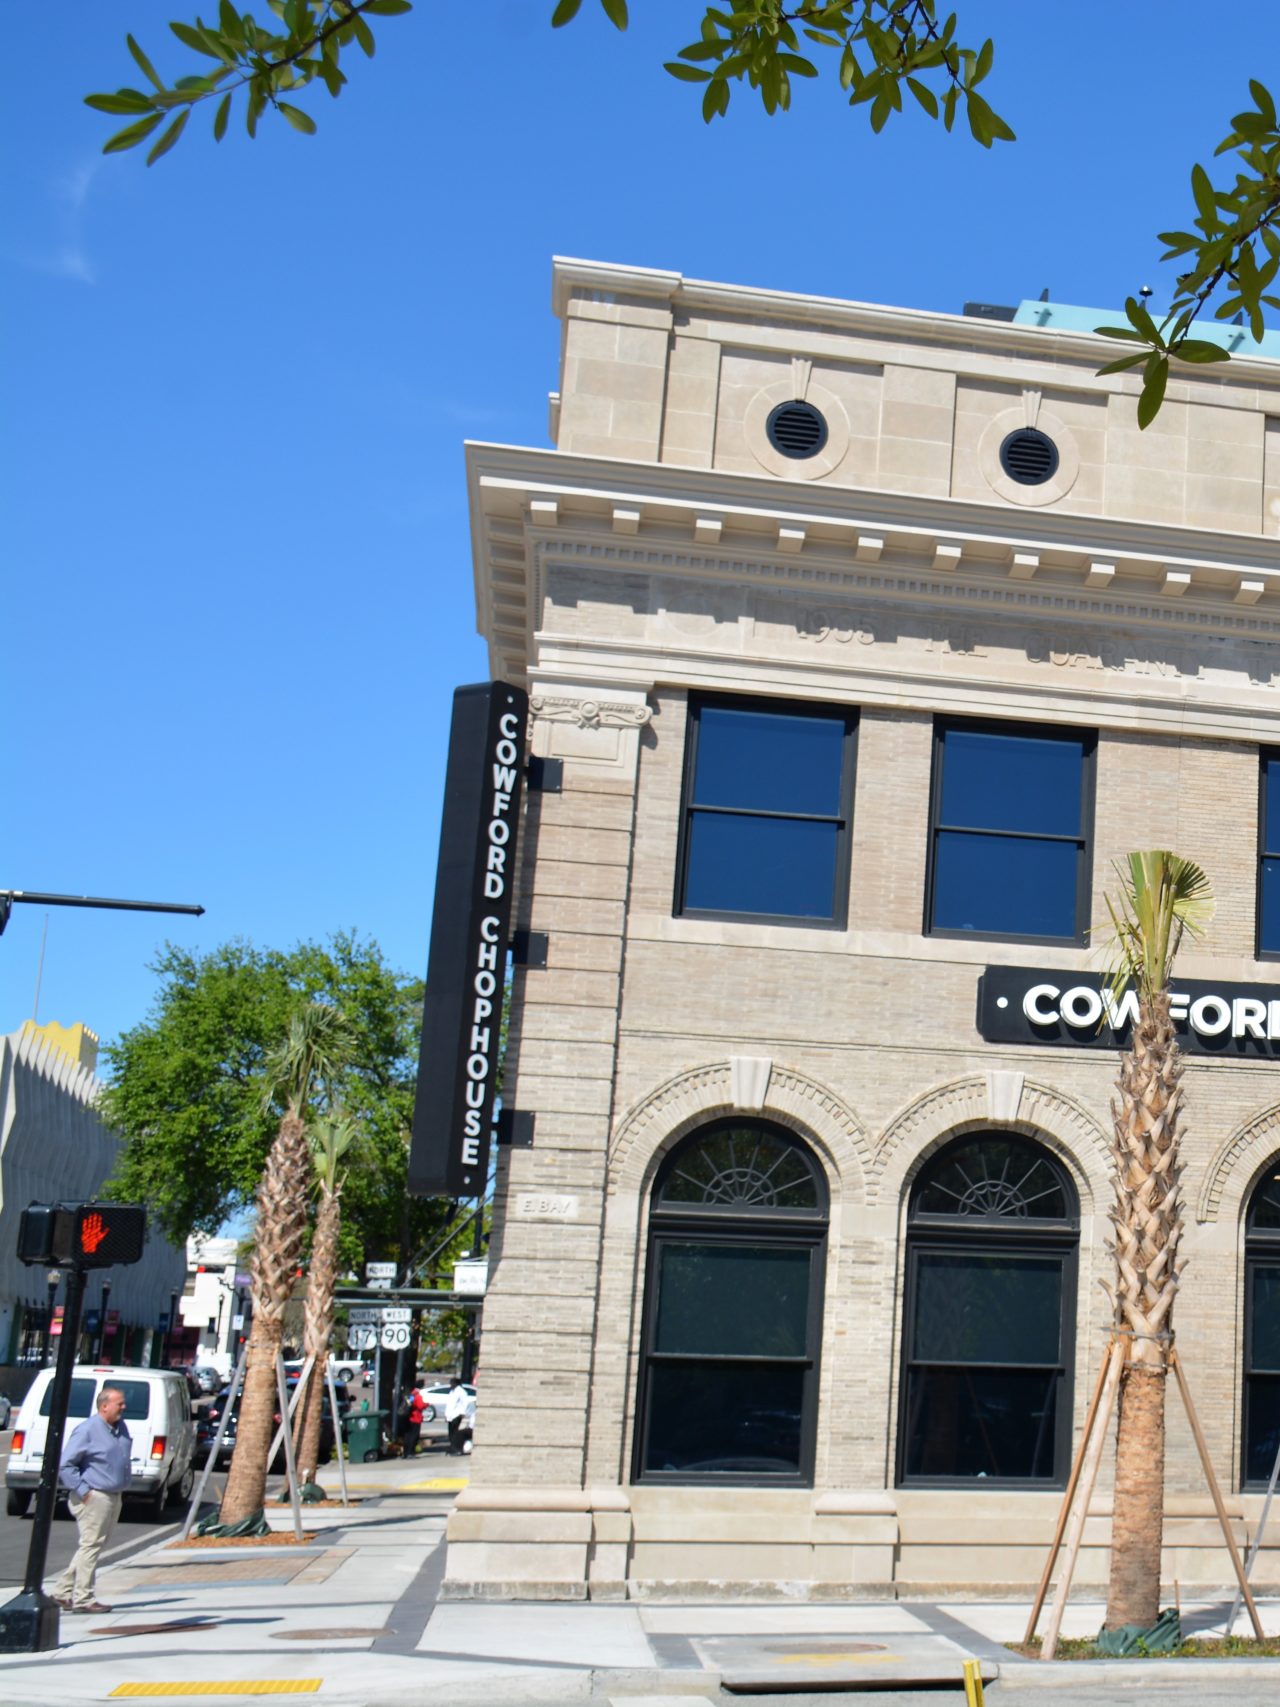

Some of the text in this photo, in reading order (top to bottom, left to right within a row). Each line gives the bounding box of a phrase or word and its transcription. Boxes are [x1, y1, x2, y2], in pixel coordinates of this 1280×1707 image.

[922, 620, 988, 658] THE
[484, 713, 519, 899] COWFORD
[461, 916, 500, 1165] CHOPHOUSE
[350, 1312, 377, 1321] NORTH
[355, 1329, 373, 1345] 17
[385, 1328, 407, 1344] 90
